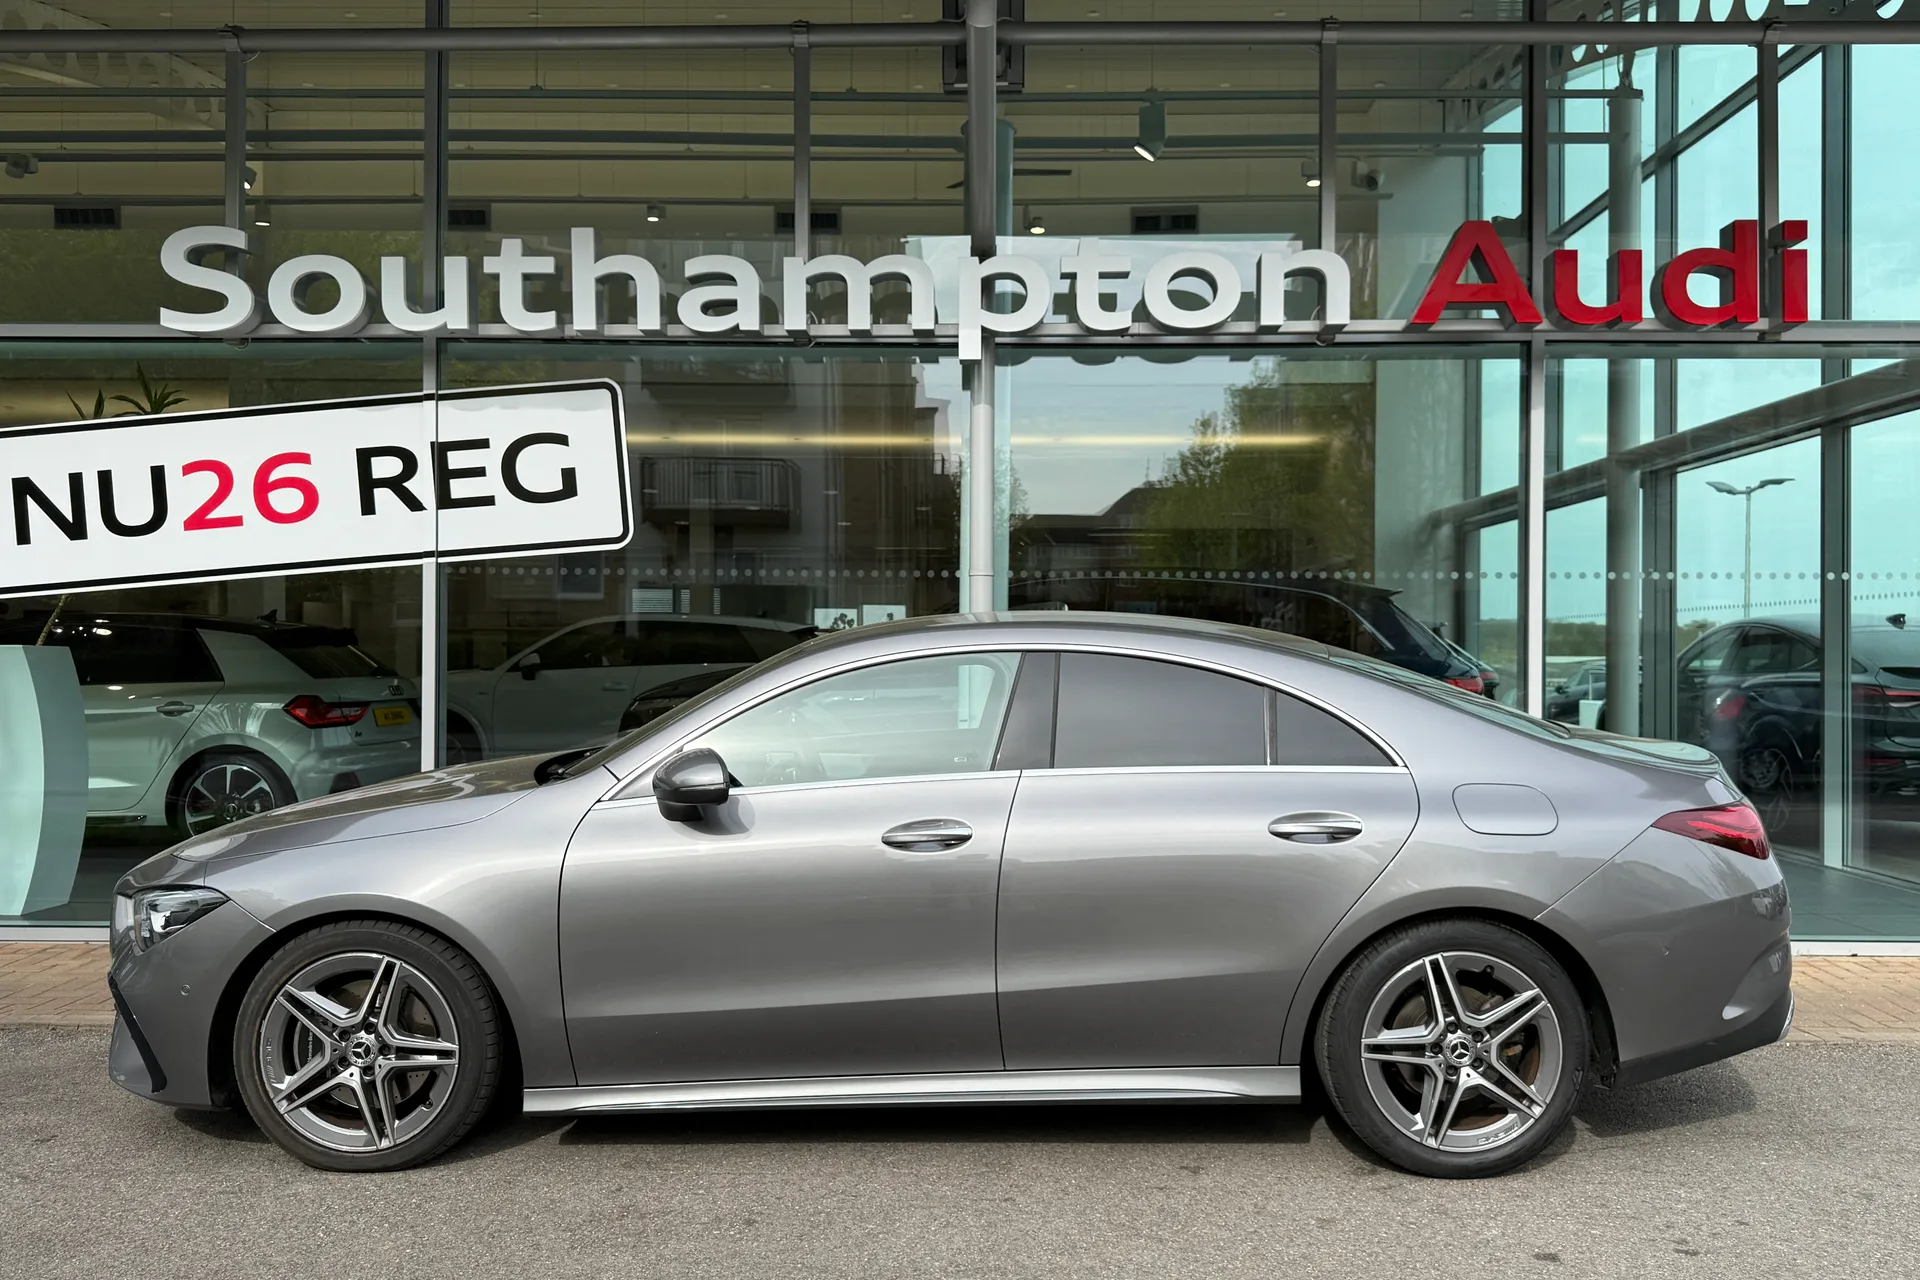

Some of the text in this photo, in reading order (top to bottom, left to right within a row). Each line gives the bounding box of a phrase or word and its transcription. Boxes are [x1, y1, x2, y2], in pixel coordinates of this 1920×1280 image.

[159, 219, 1809, 361] Southampton Audi
[11, 431, 579, 546] NU26 REG
